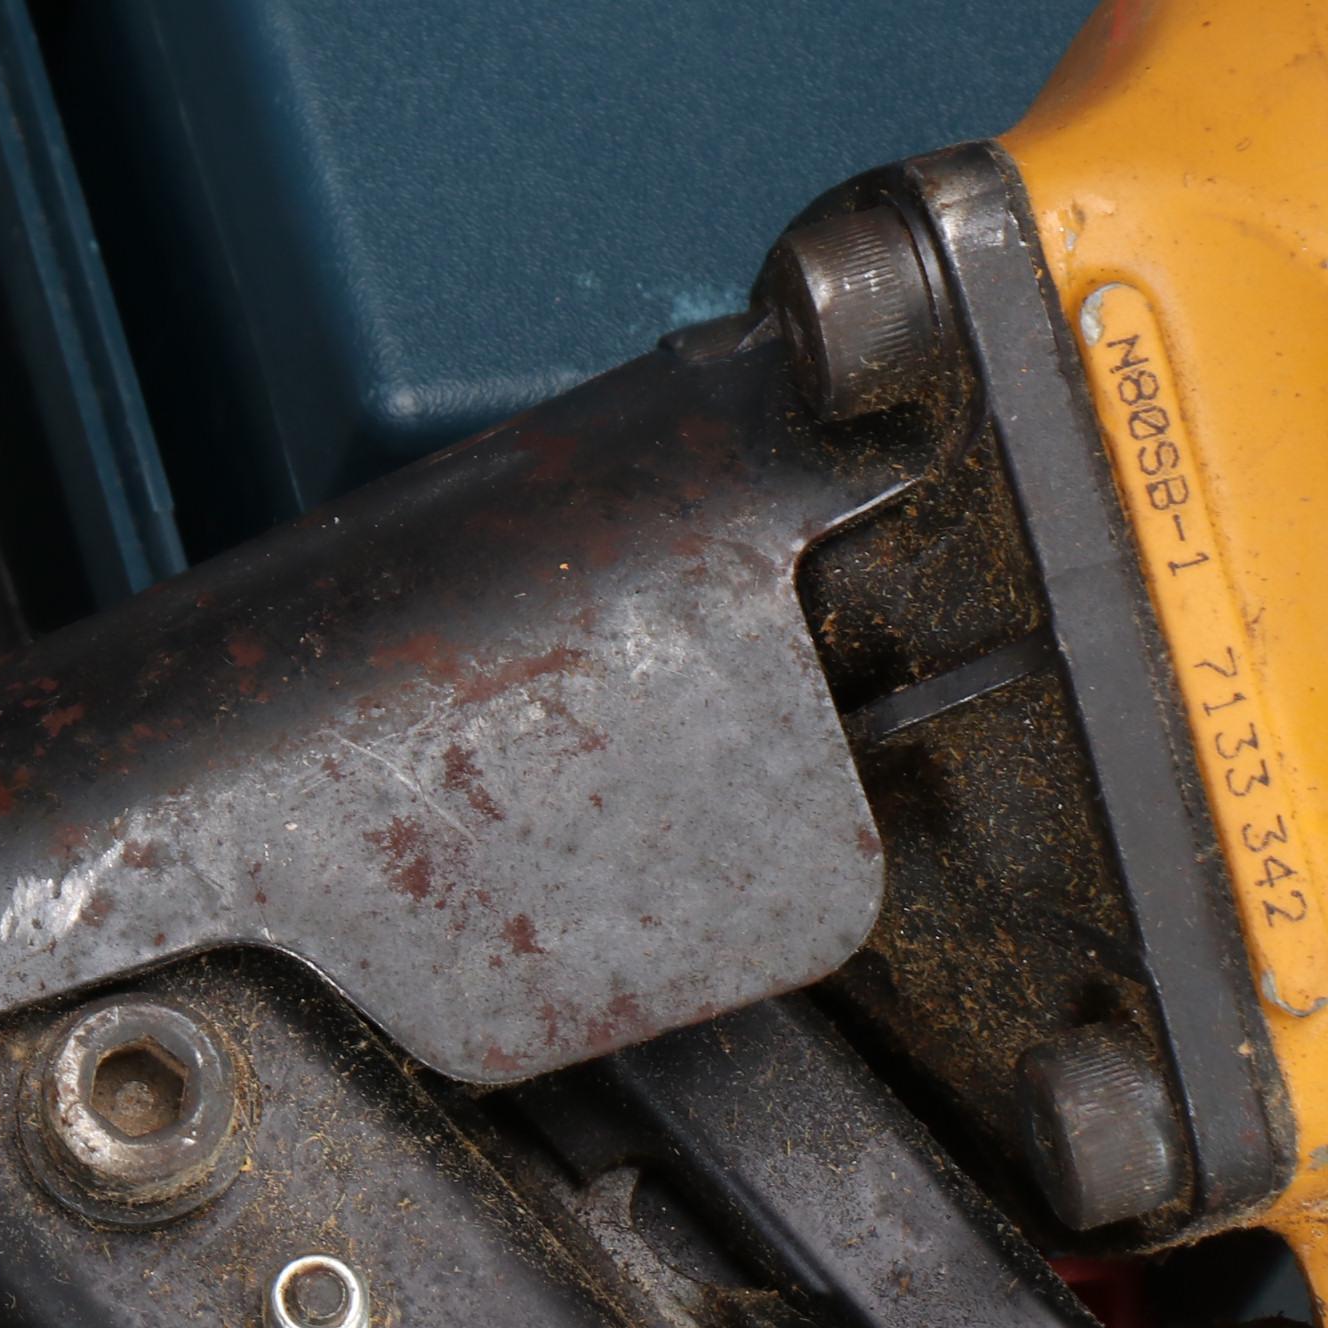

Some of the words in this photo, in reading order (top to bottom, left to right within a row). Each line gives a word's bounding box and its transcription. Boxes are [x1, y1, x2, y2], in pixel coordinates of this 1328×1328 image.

[1106, 334, 1210, 577] N80SB-1
[1193, 646, 1271, 798] 7133
[1241, 814, 1308, 928] 342
